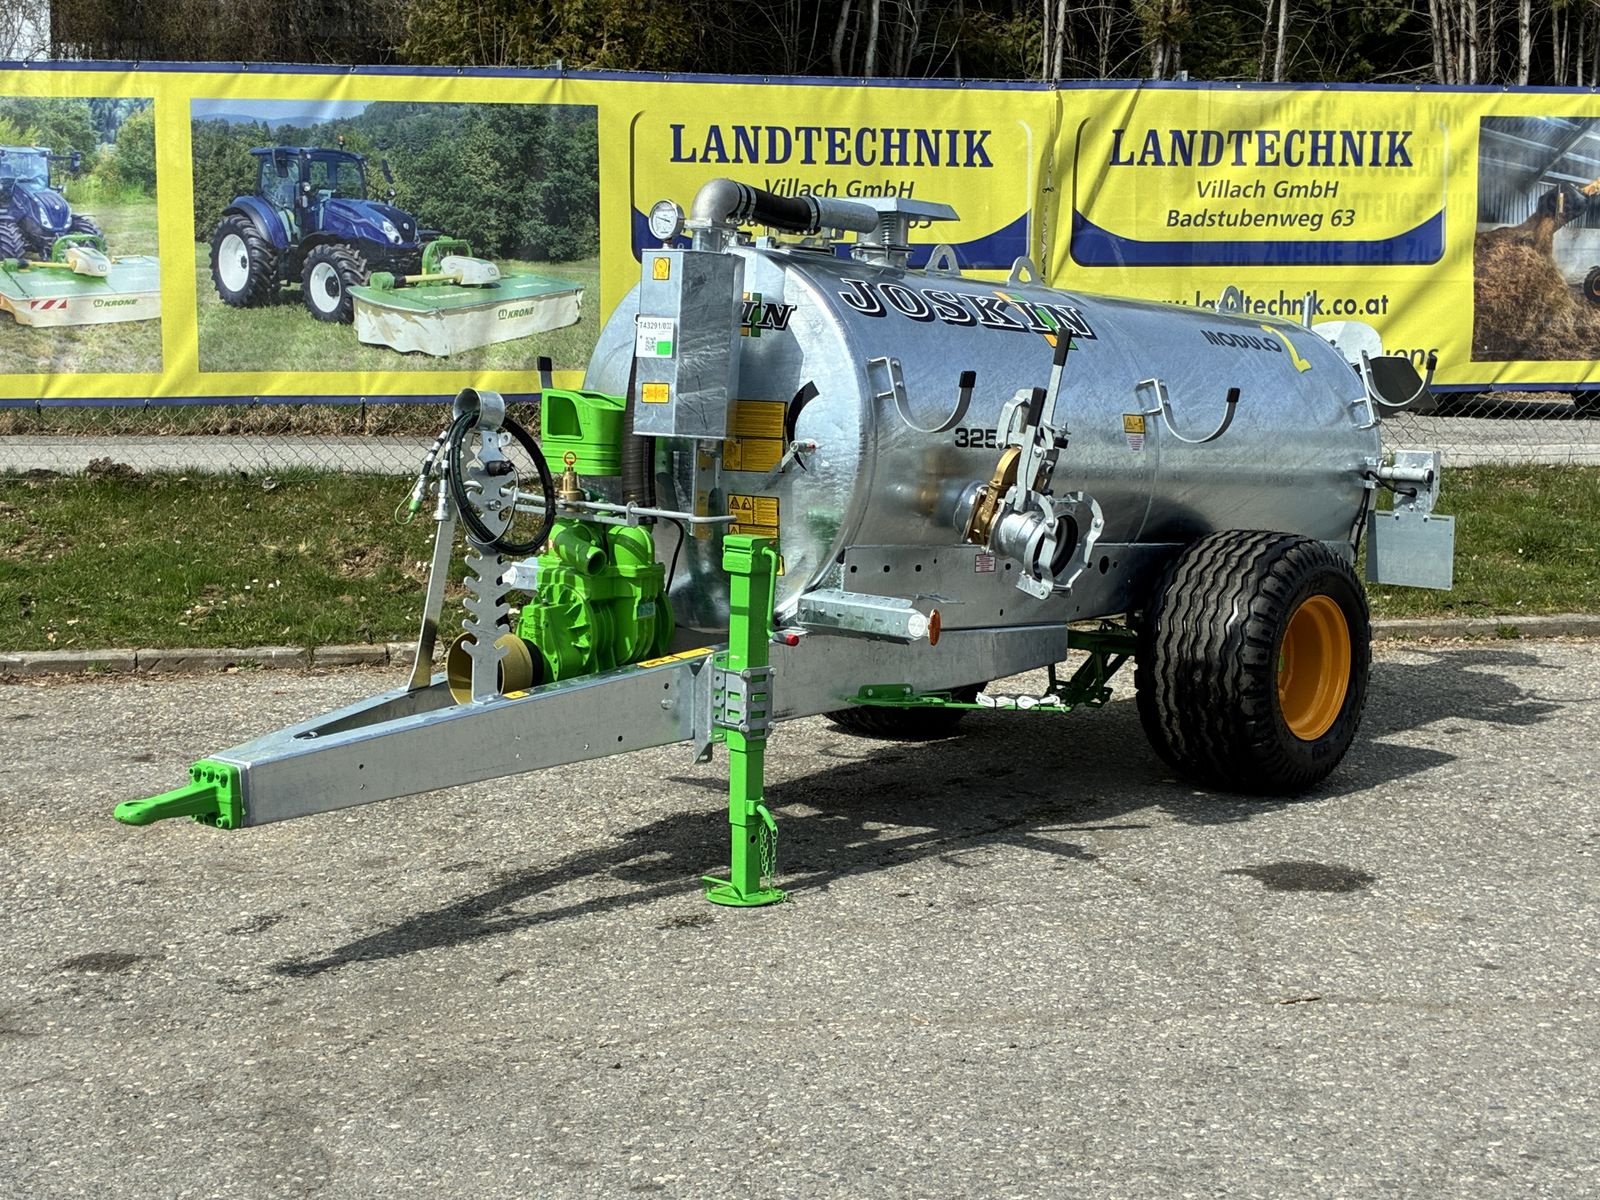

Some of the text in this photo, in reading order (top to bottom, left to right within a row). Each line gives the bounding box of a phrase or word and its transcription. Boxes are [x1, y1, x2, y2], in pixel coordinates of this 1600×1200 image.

[670, 124, 993, 167] LANDTECHNIK
[1109, 129, 1413, 167] LANDTECHNIK
[765, 178, 915, 199] Villach GmbH
[1196, 179, 1339, 199] Villach GmbH
[1166, 209, 1356, 231] Badstubenweg 63
[103, 299, 138, 307] KRONE
[507, 306, 535, 319] KRONE
[838, 277, 1098, 340] JOSKIN
[1200, 328, 1283, 353] MODULO
[954, 427, 1011, 449] 325
